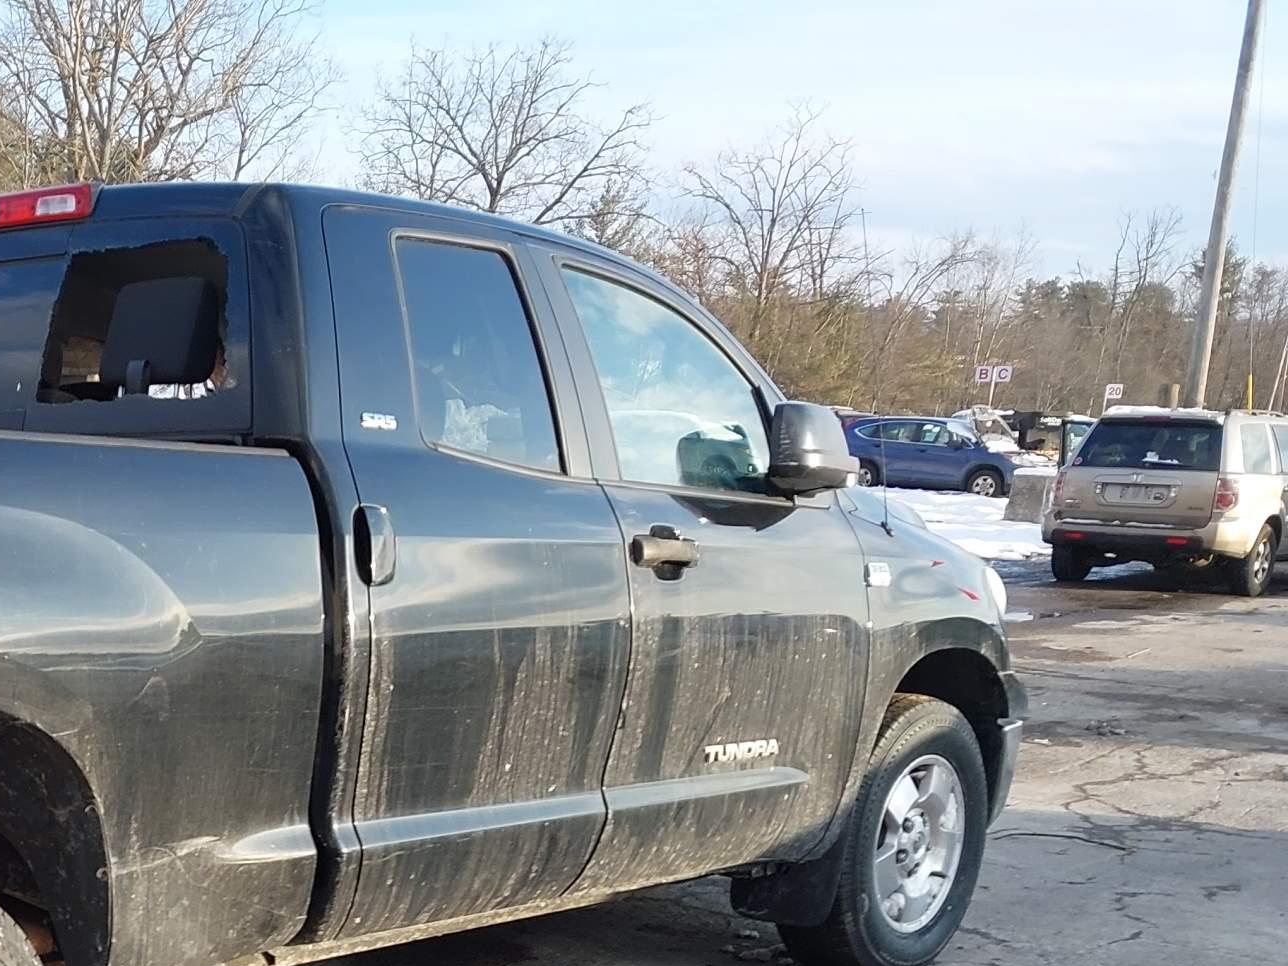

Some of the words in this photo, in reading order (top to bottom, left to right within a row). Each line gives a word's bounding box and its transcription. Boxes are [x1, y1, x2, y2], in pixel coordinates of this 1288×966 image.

[978, 368, 989, 380] B
[997, 368, 1009, 380] C
[1108, 386, 1121, 396] 20
[704, 738, 779, 764] TUNDRA
